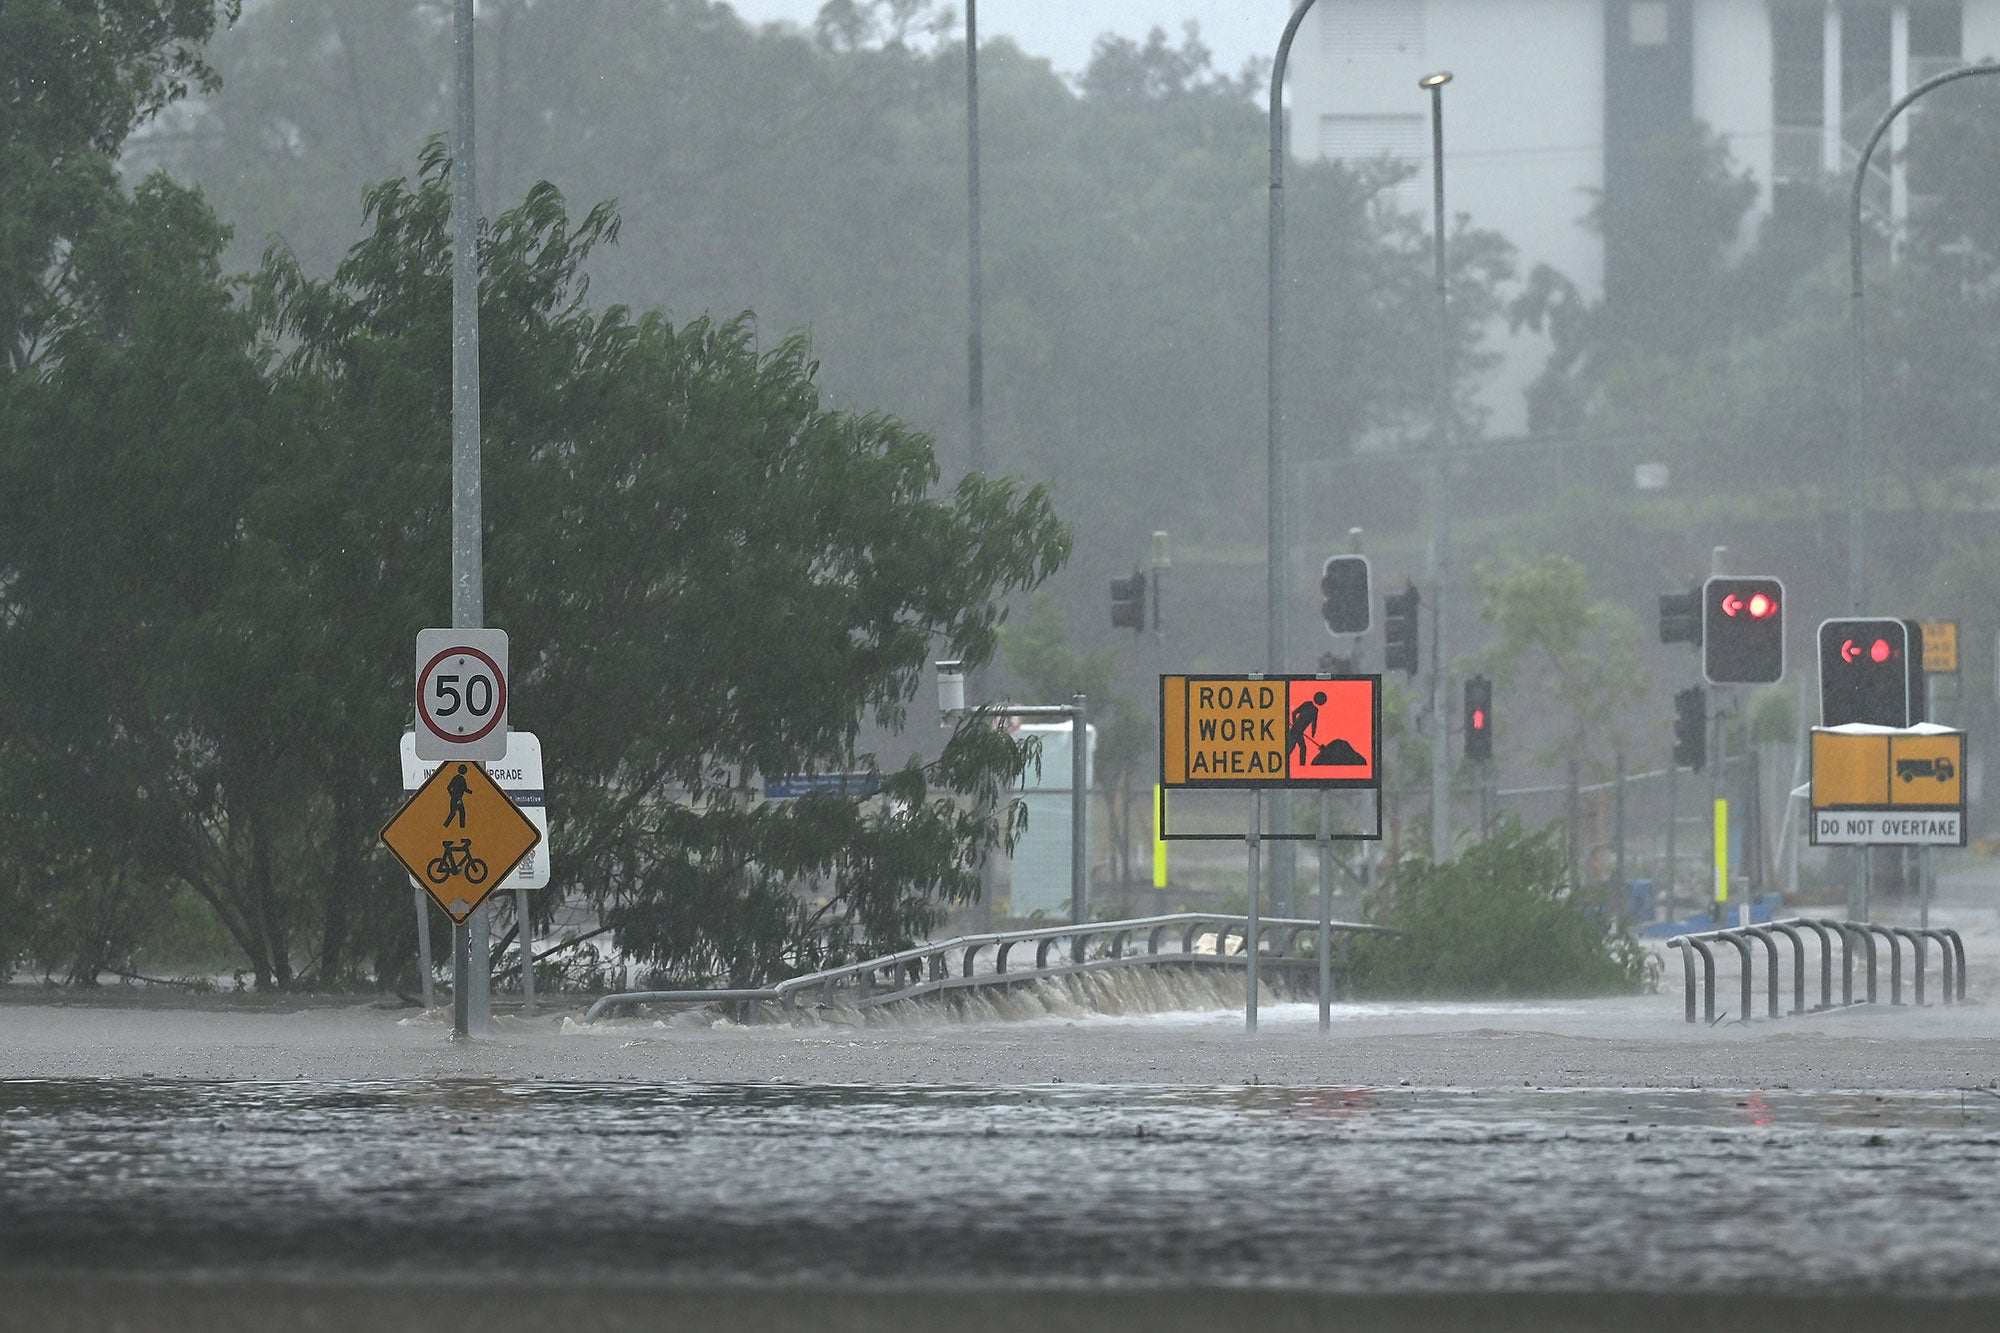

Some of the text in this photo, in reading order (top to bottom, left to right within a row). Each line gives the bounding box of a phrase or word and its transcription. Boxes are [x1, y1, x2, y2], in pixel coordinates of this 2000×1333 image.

[435, 674, 493, 717] 50
[1199, 686, 1275, 710] ROAD
[1198, 718, 1275, 742] WORK
[487, 768, 523, 780] PGRADE
[1191, 750, 1283, 774] AHEAD
[1820, 819, 1957, 836] DO NOT OVERTAKE
